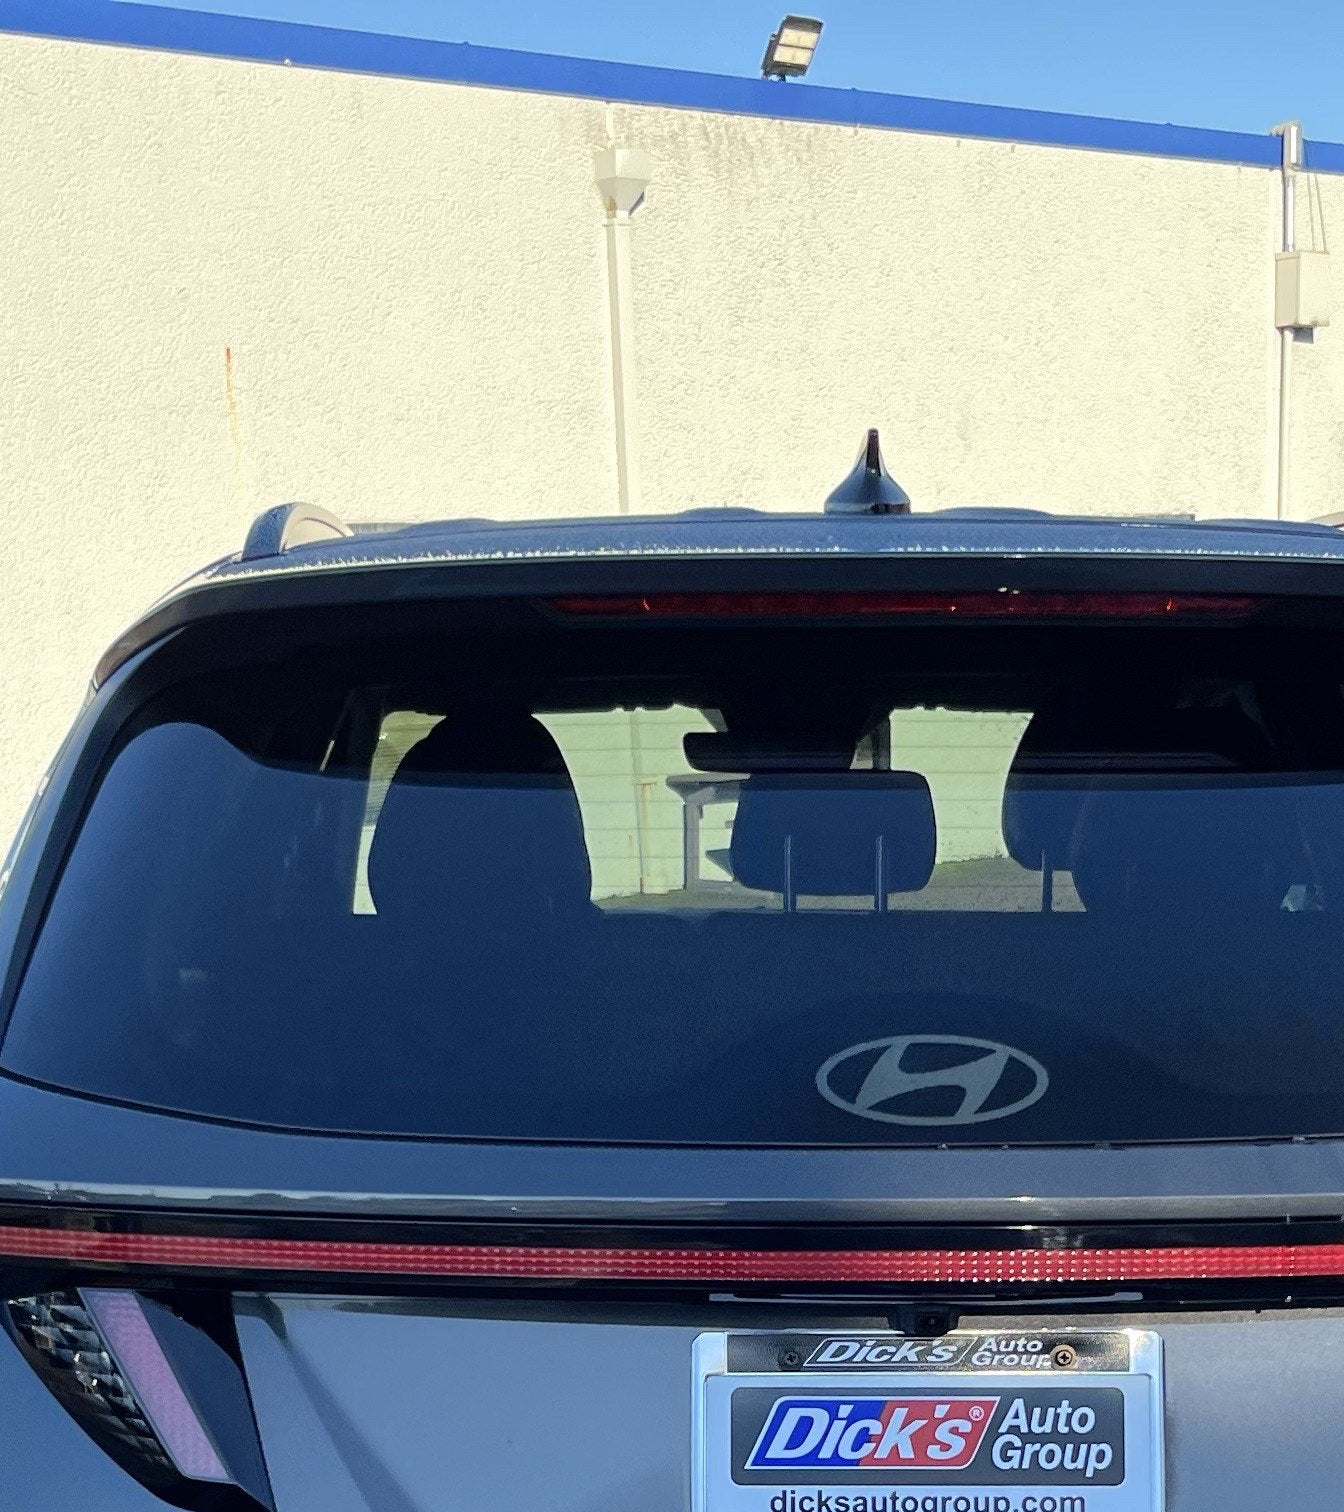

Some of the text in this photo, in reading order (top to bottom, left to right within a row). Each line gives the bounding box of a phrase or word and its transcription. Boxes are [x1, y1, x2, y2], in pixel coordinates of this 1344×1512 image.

[815, 1339, 959, 1363] Dick's
[977, 1336, 1044, 1352] Auto
[764, 1403, 973, 1460] Dick's
[998, 1397, 1096, 1434] Auto
[991, 1433, 1113, 1478] Group
